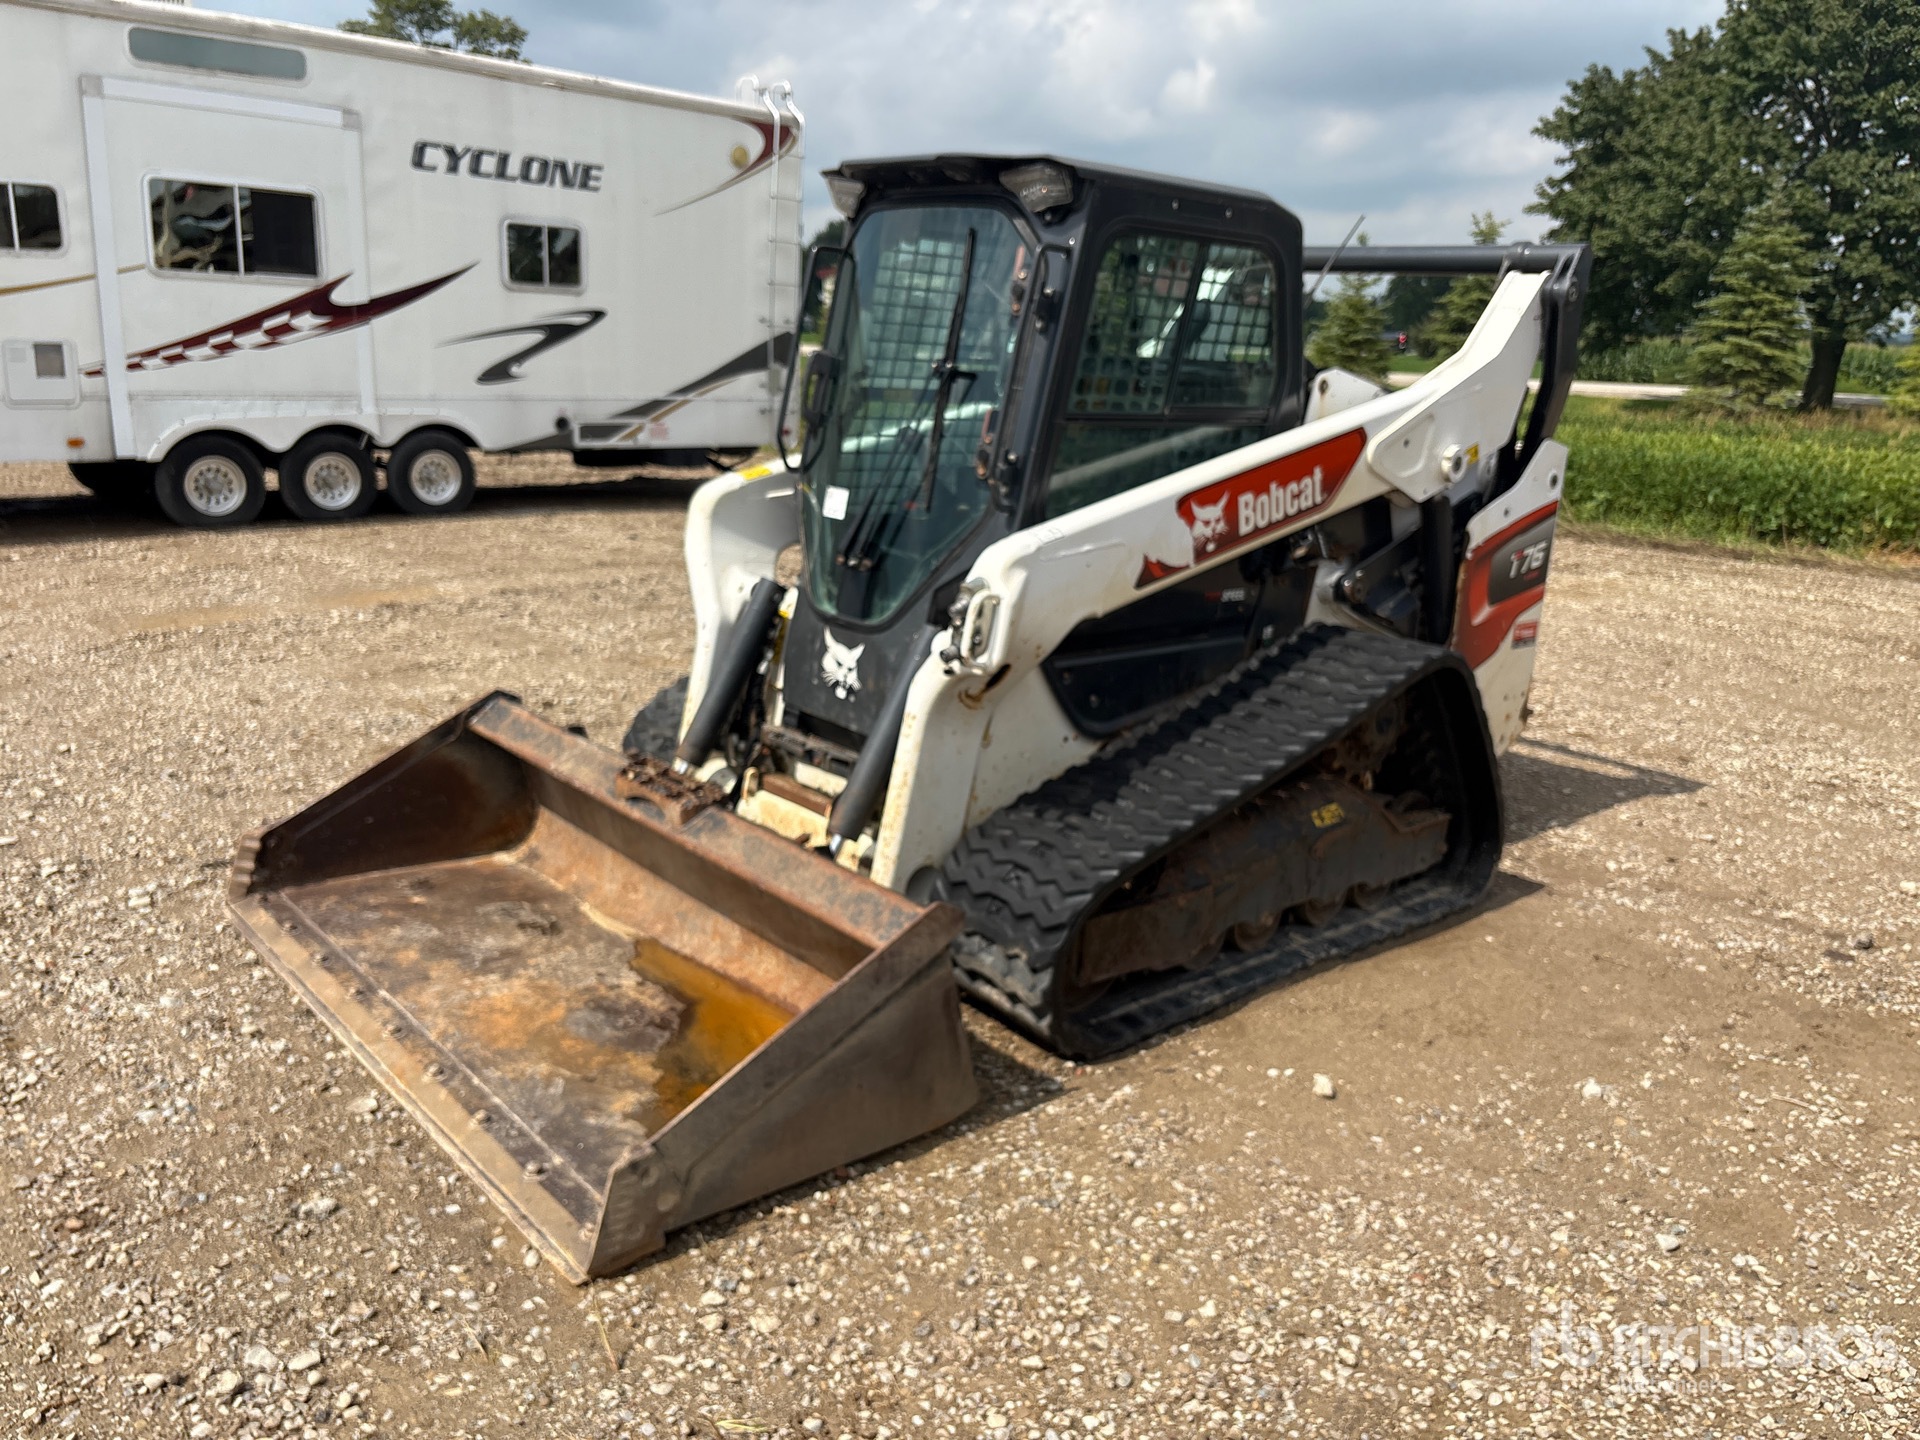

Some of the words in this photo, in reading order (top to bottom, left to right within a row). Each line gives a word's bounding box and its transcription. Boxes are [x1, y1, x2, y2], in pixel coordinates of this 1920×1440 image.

[410, 139, 604, 193] CYCLONE
[1237, 464, 1323, 537] Bobcat
[1509, 540, 1548, 579] T76
